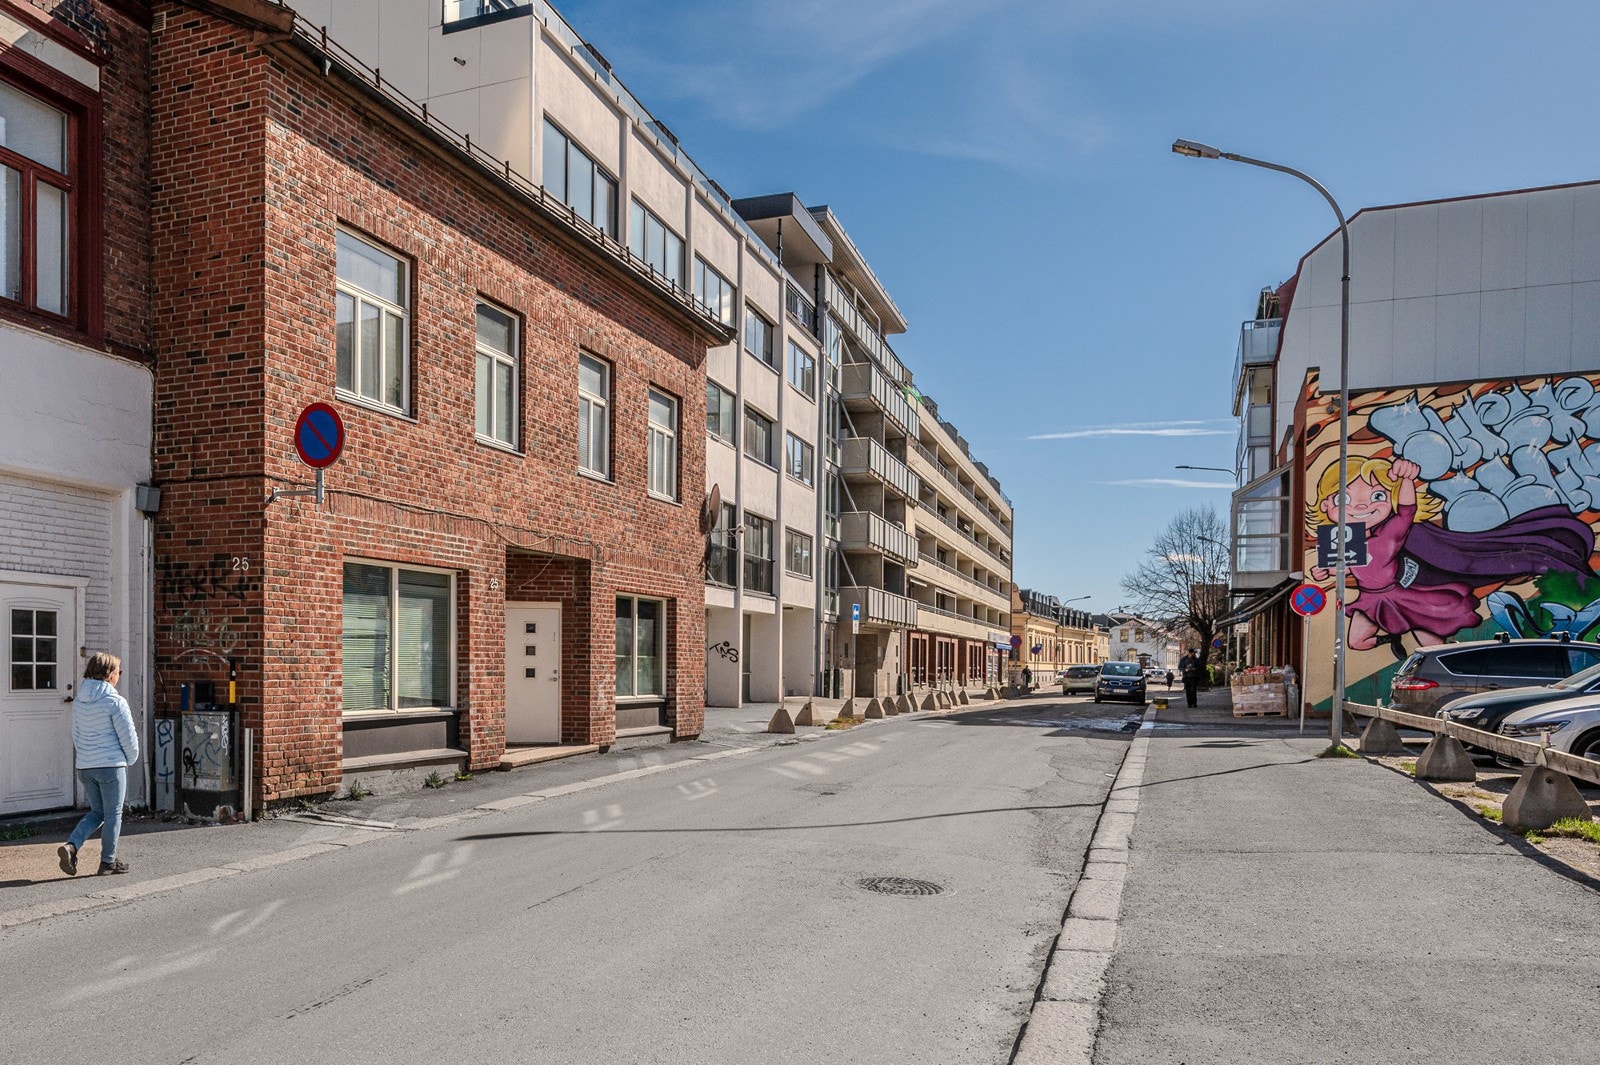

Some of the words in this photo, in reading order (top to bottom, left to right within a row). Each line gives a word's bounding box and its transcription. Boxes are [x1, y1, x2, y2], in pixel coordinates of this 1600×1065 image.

[1330, 526, 1353, 550] P
[232, 557, 249, 571] 25
[490, 577, 499, 590] 25
